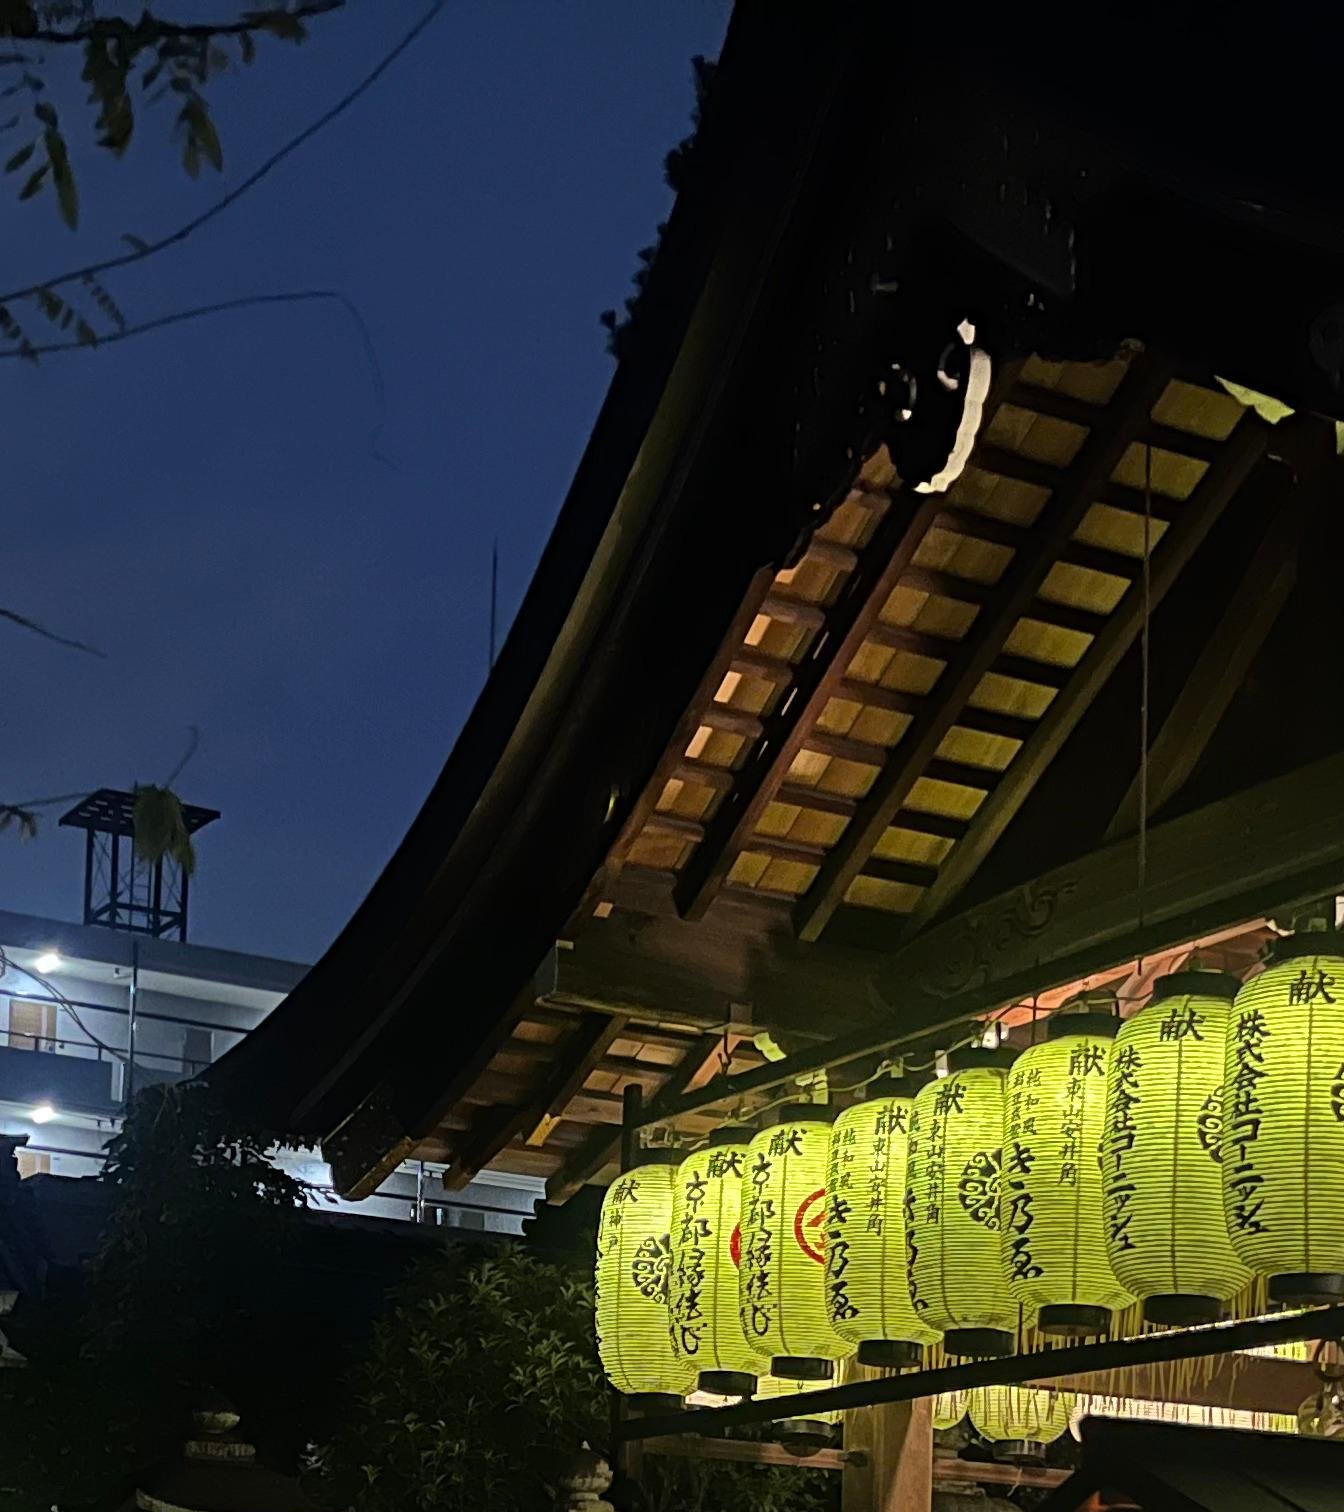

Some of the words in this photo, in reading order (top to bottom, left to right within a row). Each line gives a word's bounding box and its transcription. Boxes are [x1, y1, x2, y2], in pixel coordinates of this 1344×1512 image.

[1288, 968, 1338, 1005] 献
[1159, 1007, 1205, 1042] 献
[1068, 1043, 1107, 1077] 献
[934, 1082, 967, 1116] 献
[874, 1105, 909, 1136] 献
[1057, 1077, 1084, 1186] 東山安井角
[767, 1128, 807, 1157] 献
[707, 1151, 747, 1179] 献
[612, 1178, 641, 1205] 献
